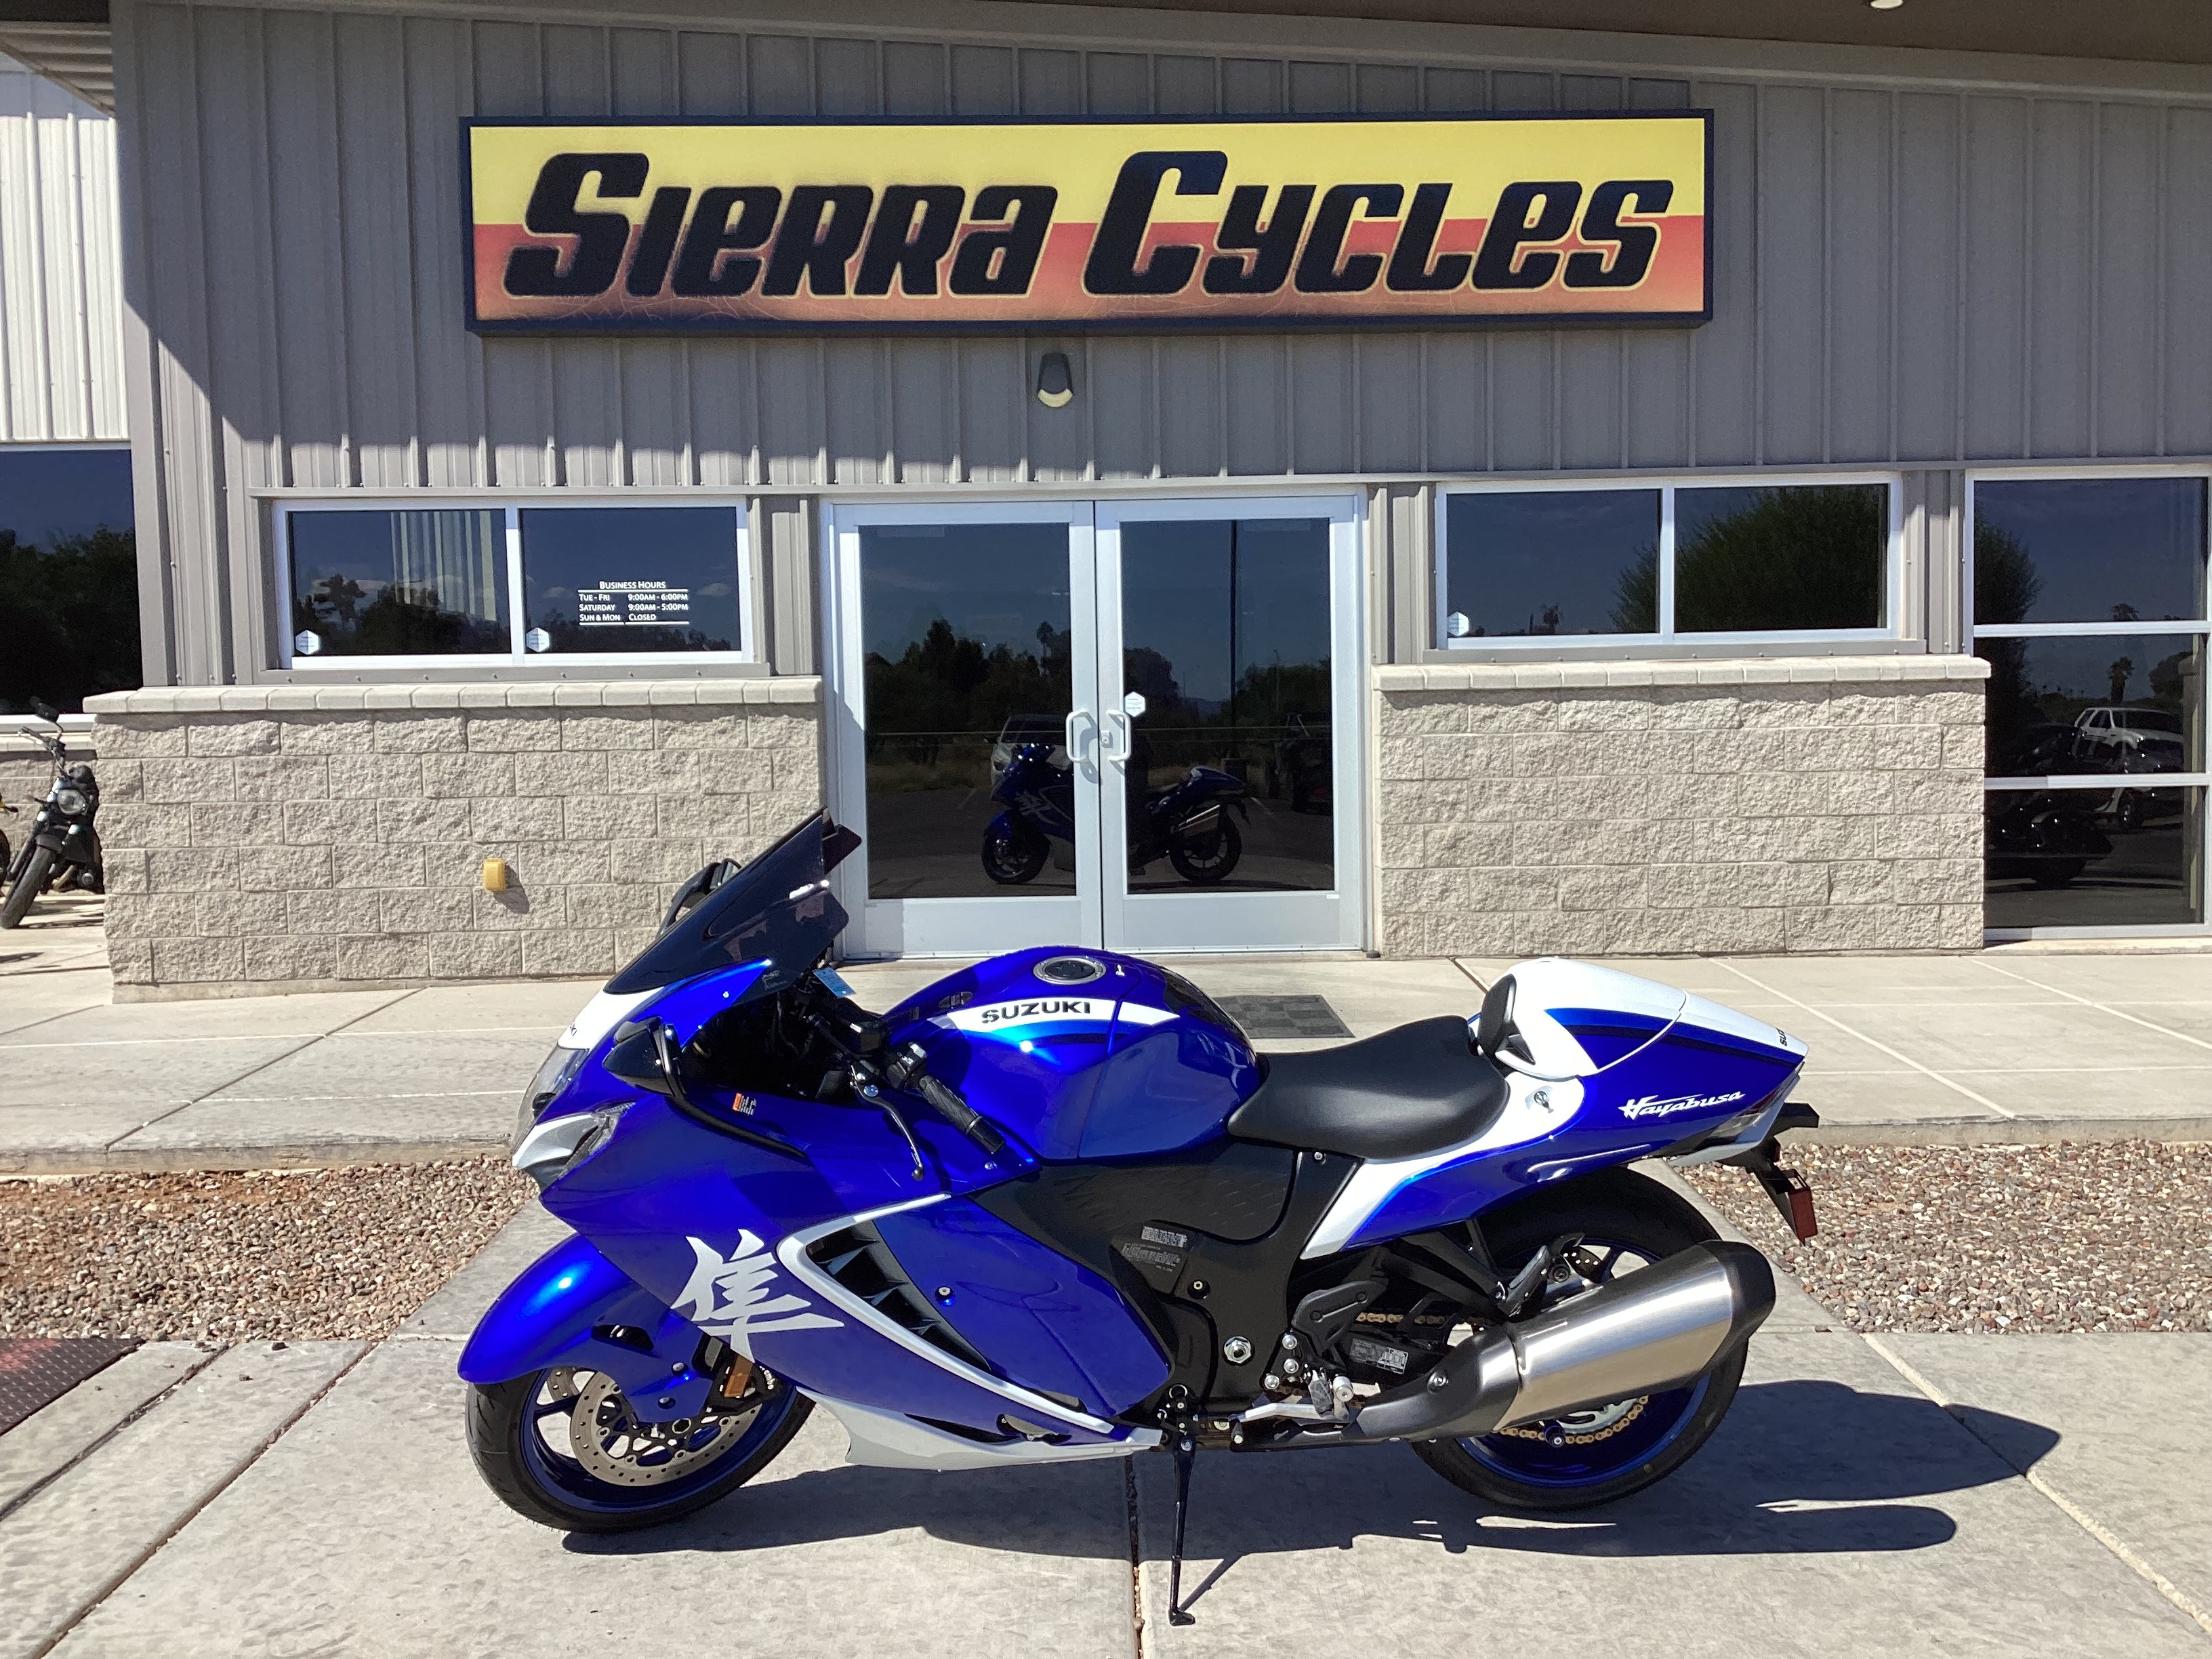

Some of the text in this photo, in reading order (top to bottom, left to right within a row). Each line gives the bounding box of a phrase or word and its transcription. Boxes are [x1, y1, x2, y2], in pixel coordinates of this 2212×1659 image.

[981, 1000, 1090, 1024] SUZUKI
[1618, 1090, 1746, 1120] Hayabusa
[670, 1229, 845, 1364] 隼
